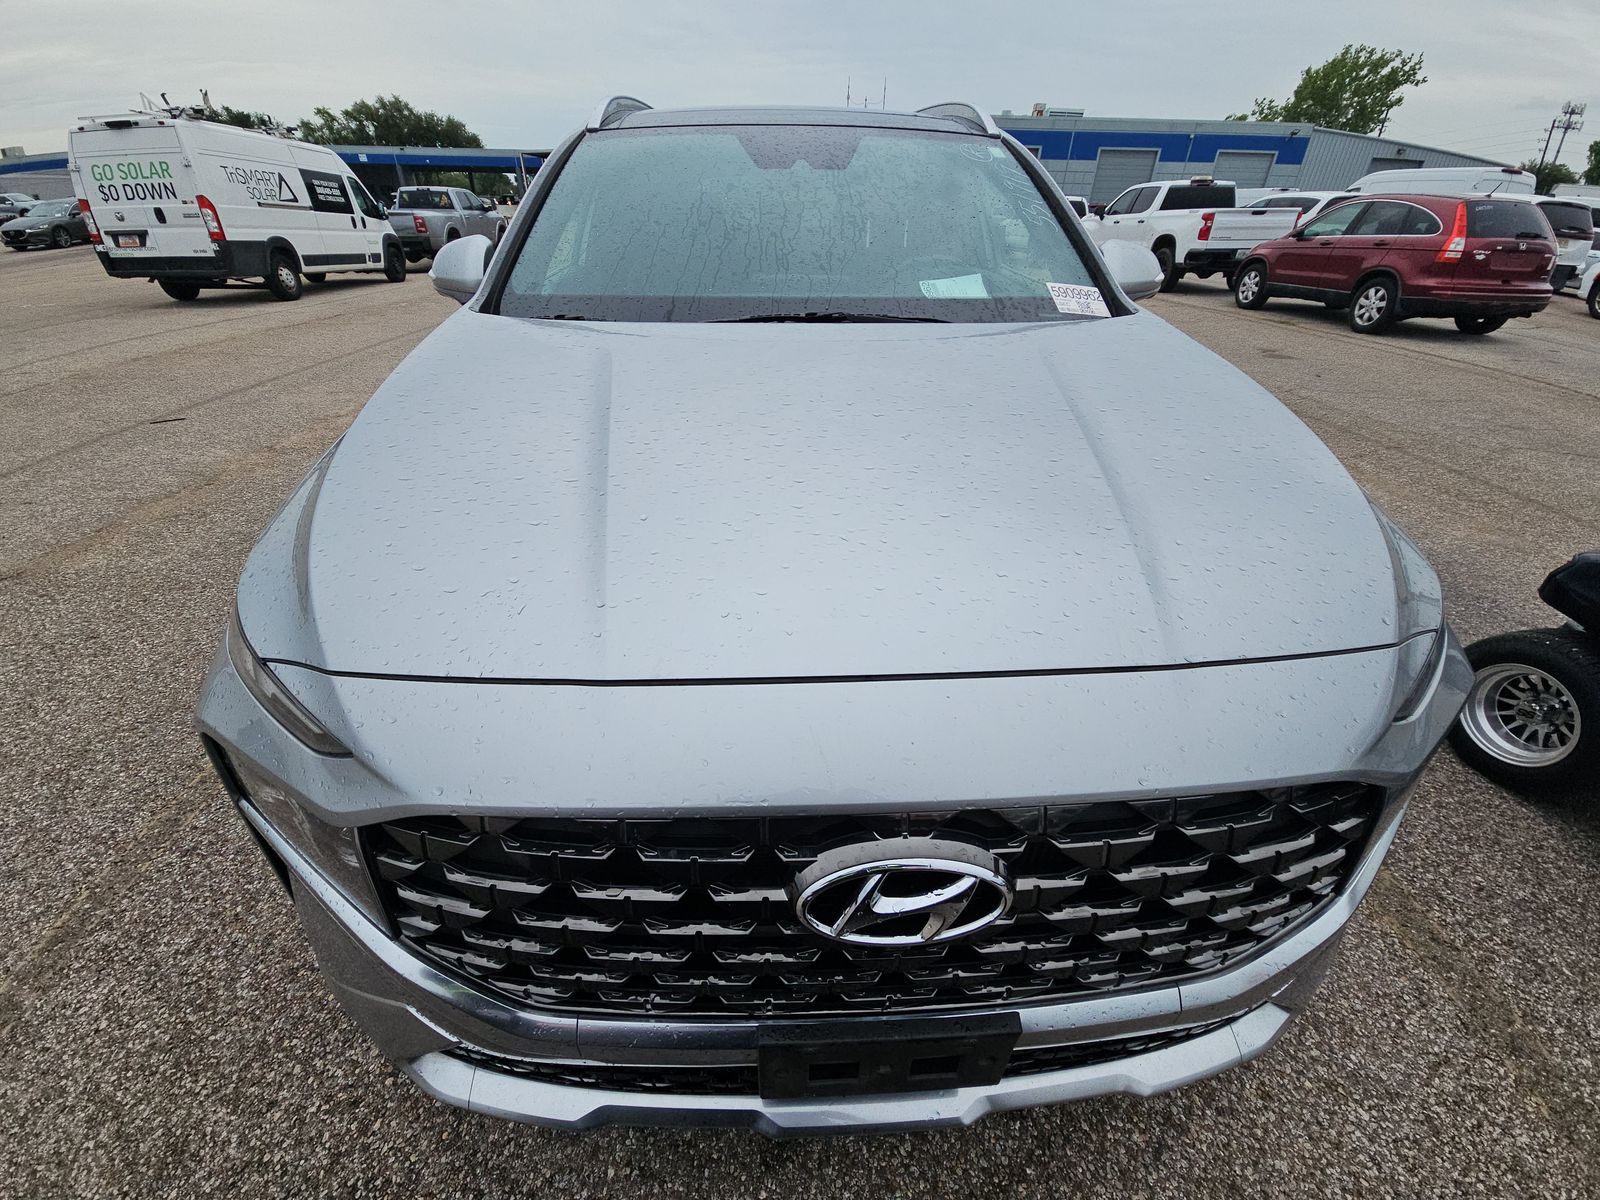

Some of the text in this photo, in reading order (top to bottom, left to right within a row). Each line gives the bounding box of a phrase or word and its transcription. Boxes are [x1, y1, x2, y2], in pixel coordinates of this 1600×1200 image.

[91, 160, 173, 181] GO SOLAR
[219, 165, 279, 188] TriSMART
[121, 182, 178, 201] DOWN
[246, 186, 280, 201] SOLAR
[1050, 286, 1103, 302] 5909962
